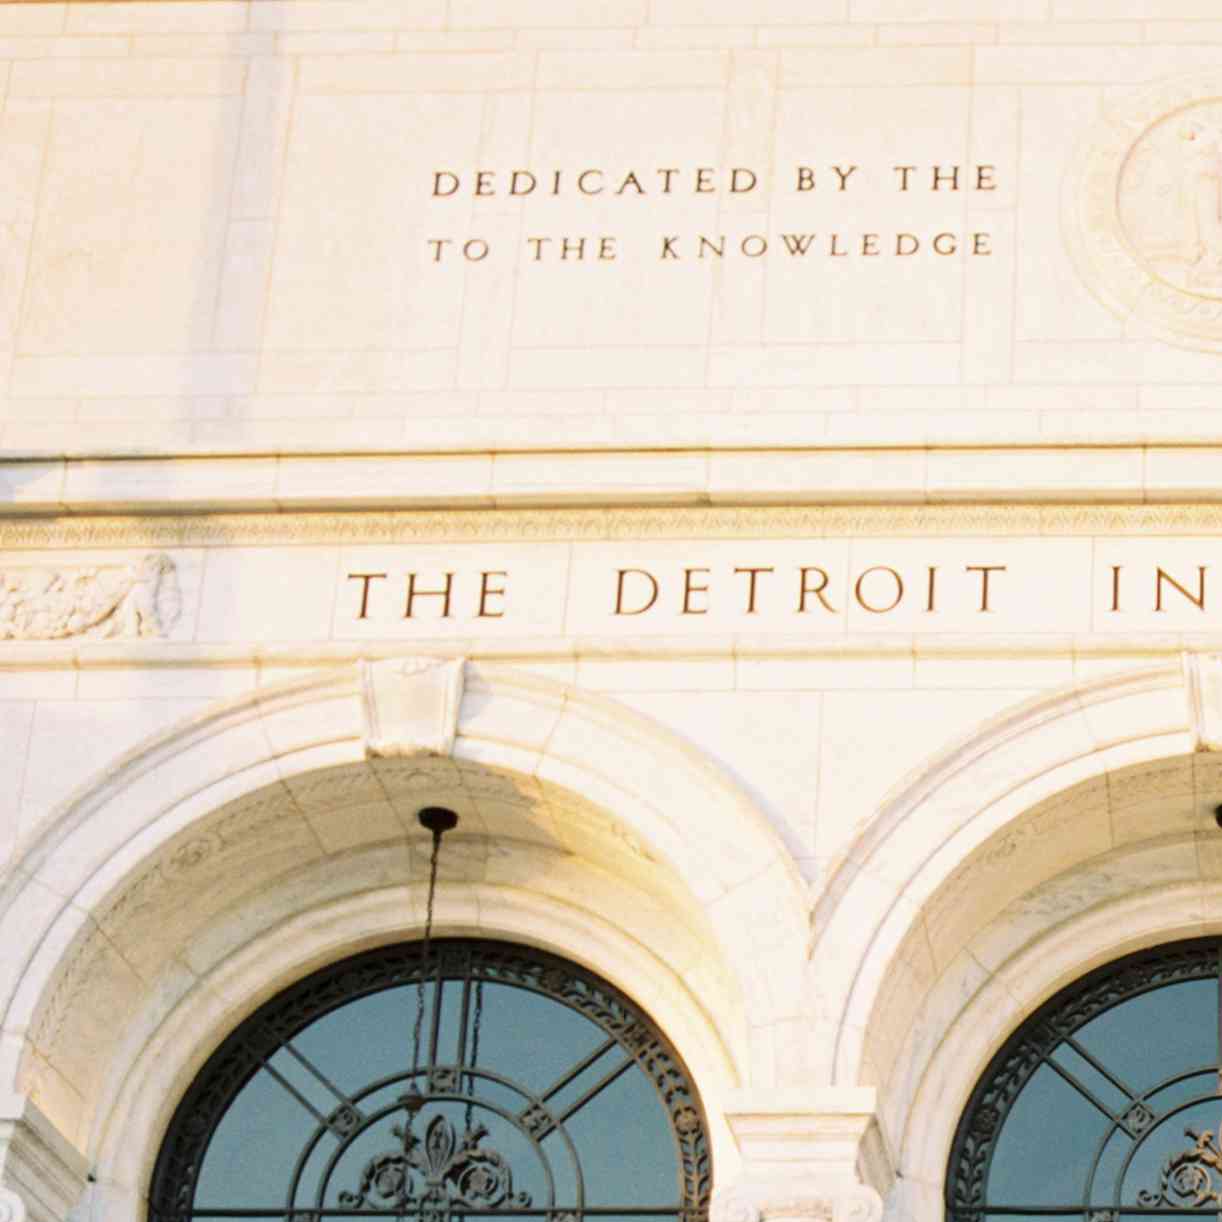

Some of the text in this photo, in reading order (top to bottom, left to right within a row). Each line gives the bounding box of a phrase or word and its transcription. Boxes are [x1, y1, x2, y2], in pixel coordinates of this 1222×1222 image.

[432, 167, 758, 197] DEDICATED
[796, 165, 857, 192] BY
[893, 165, 997, 192] THE
[427, 239, 490, 263] TO
[527, 237, 616, 261] THE
[660, 232, 991, 260] KNOWLEDGE
[347, 570, 508, 620] THE
[613, 565, 1007, 616] DETROIT
